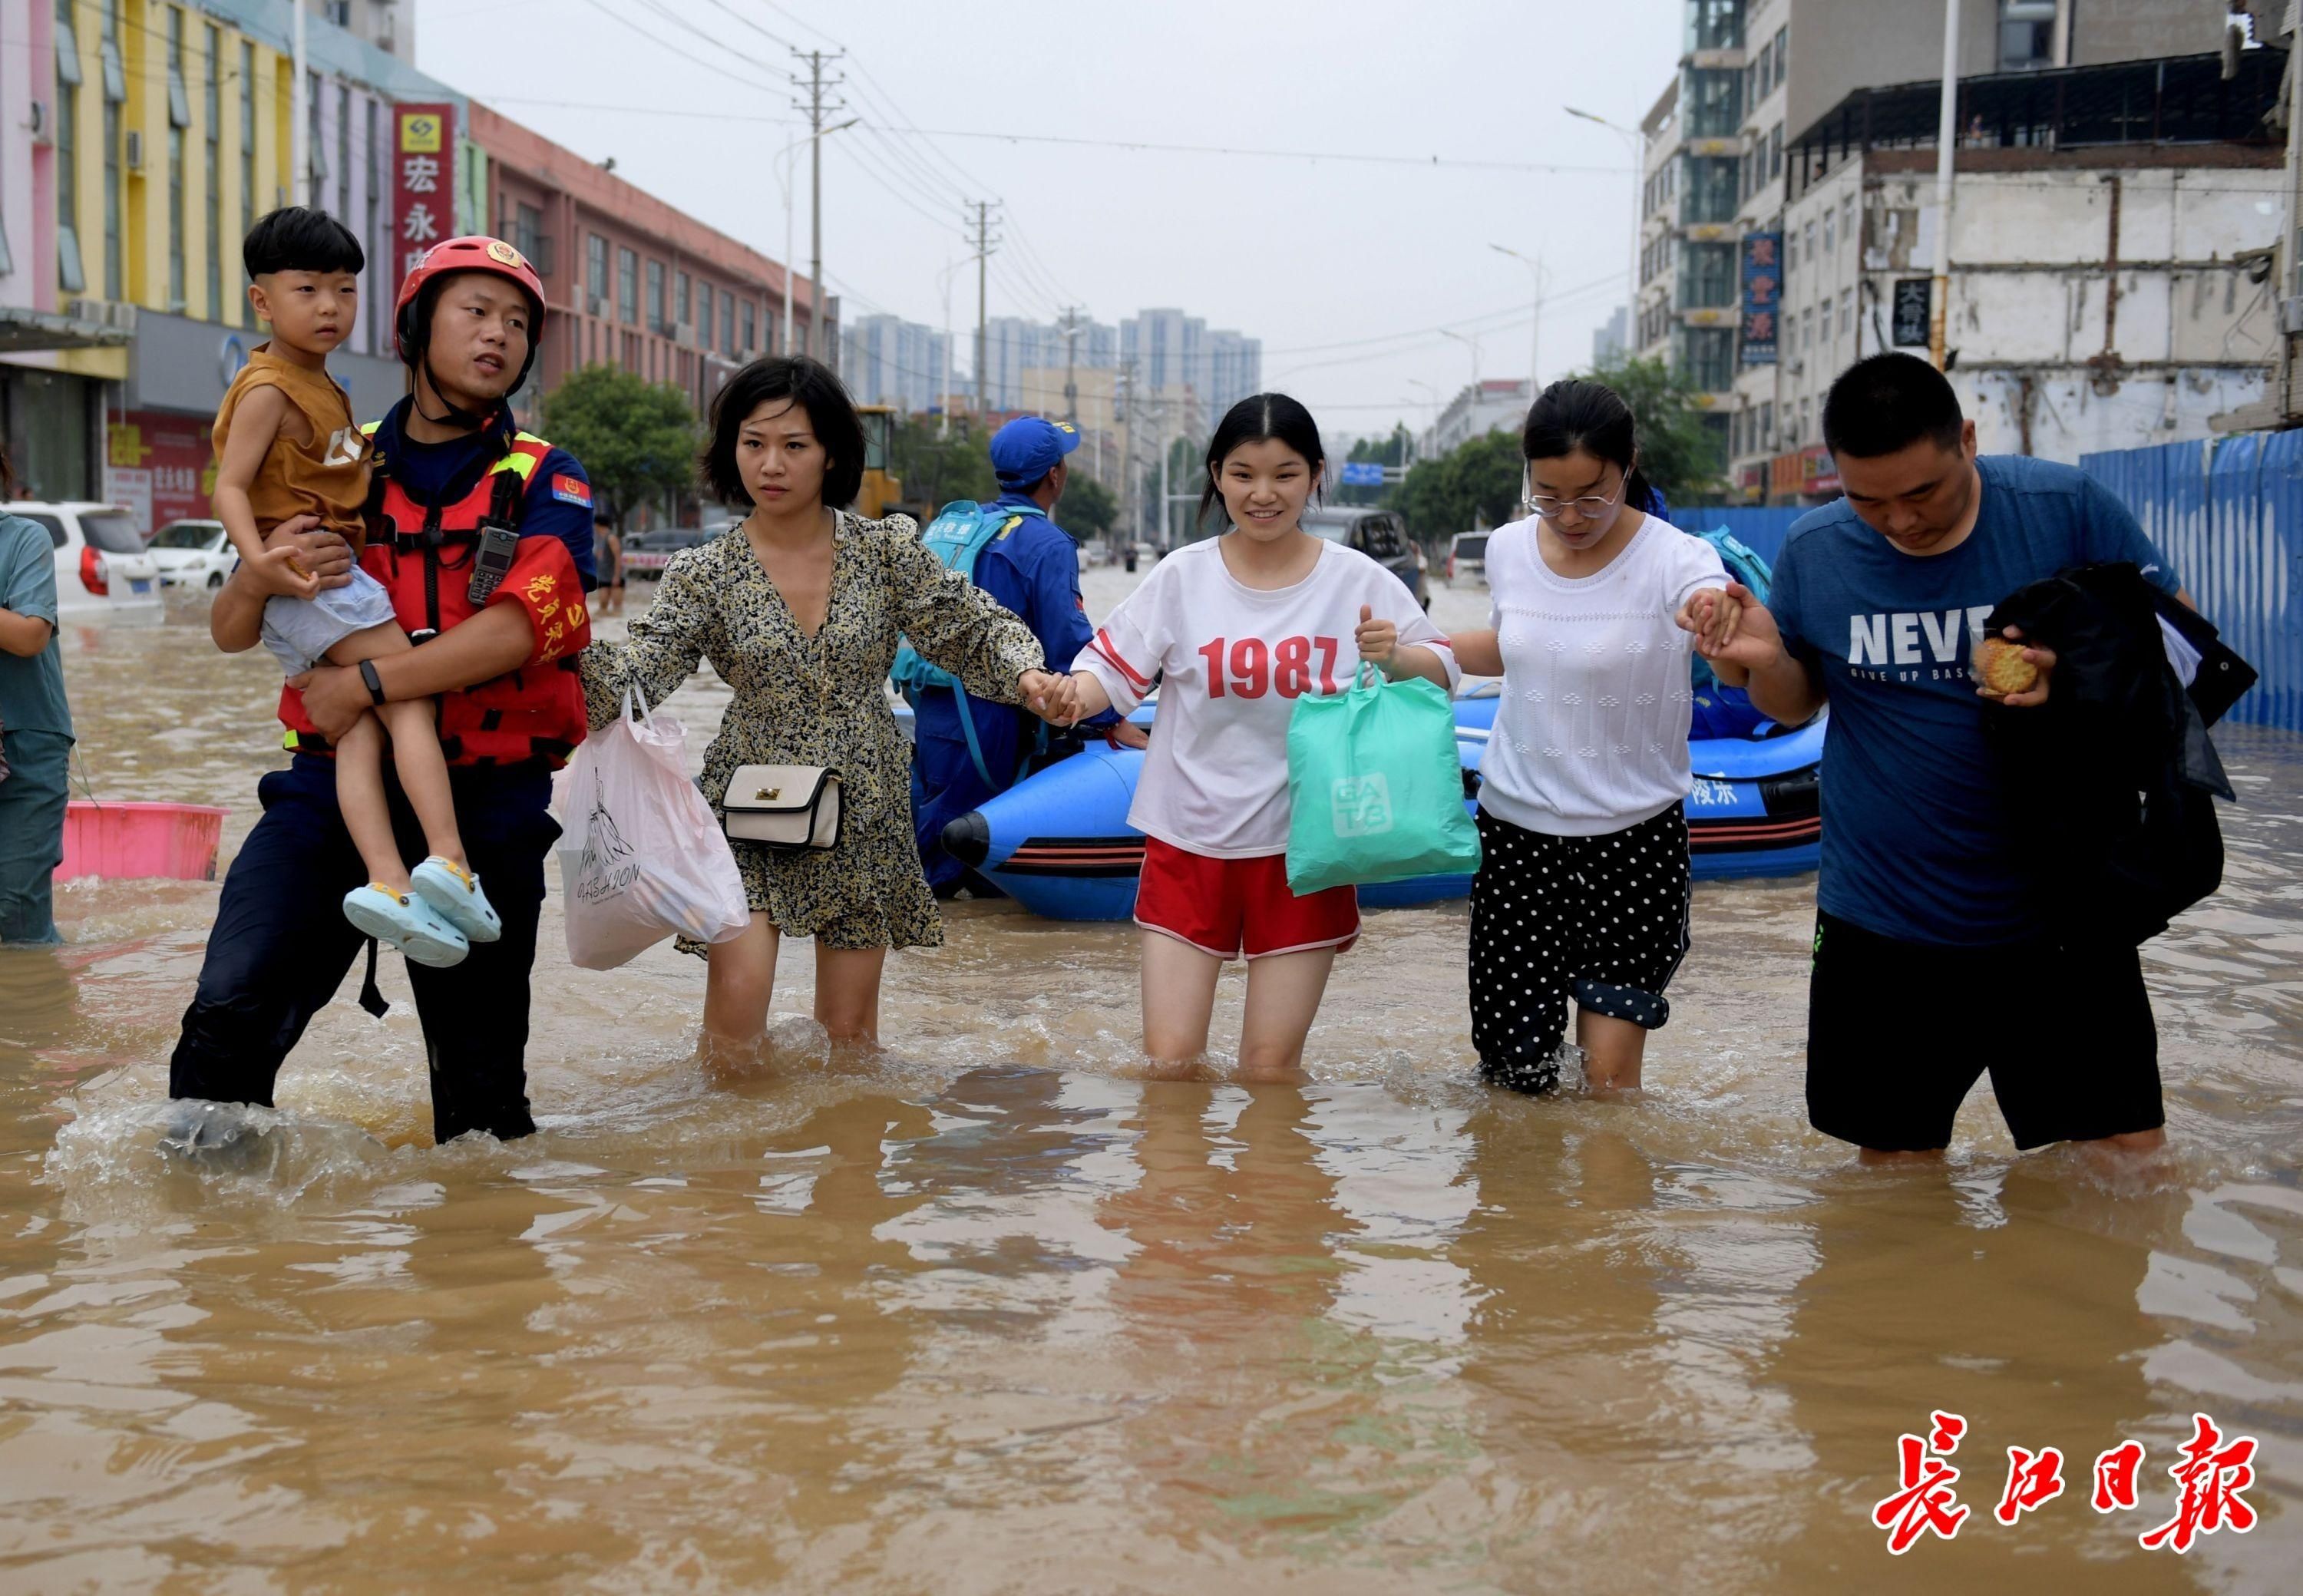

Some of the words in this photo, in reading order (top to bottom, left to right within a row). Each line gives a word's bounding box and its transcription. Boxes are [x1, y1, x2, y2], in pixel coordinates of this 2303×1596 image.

[1898, 283, 1925, 343] 大骨头
[1198, 636, 1337, 699] 1987
[1851, 668, 1887, 682] GIVE
[1900, 669, 1918, 682] UP
